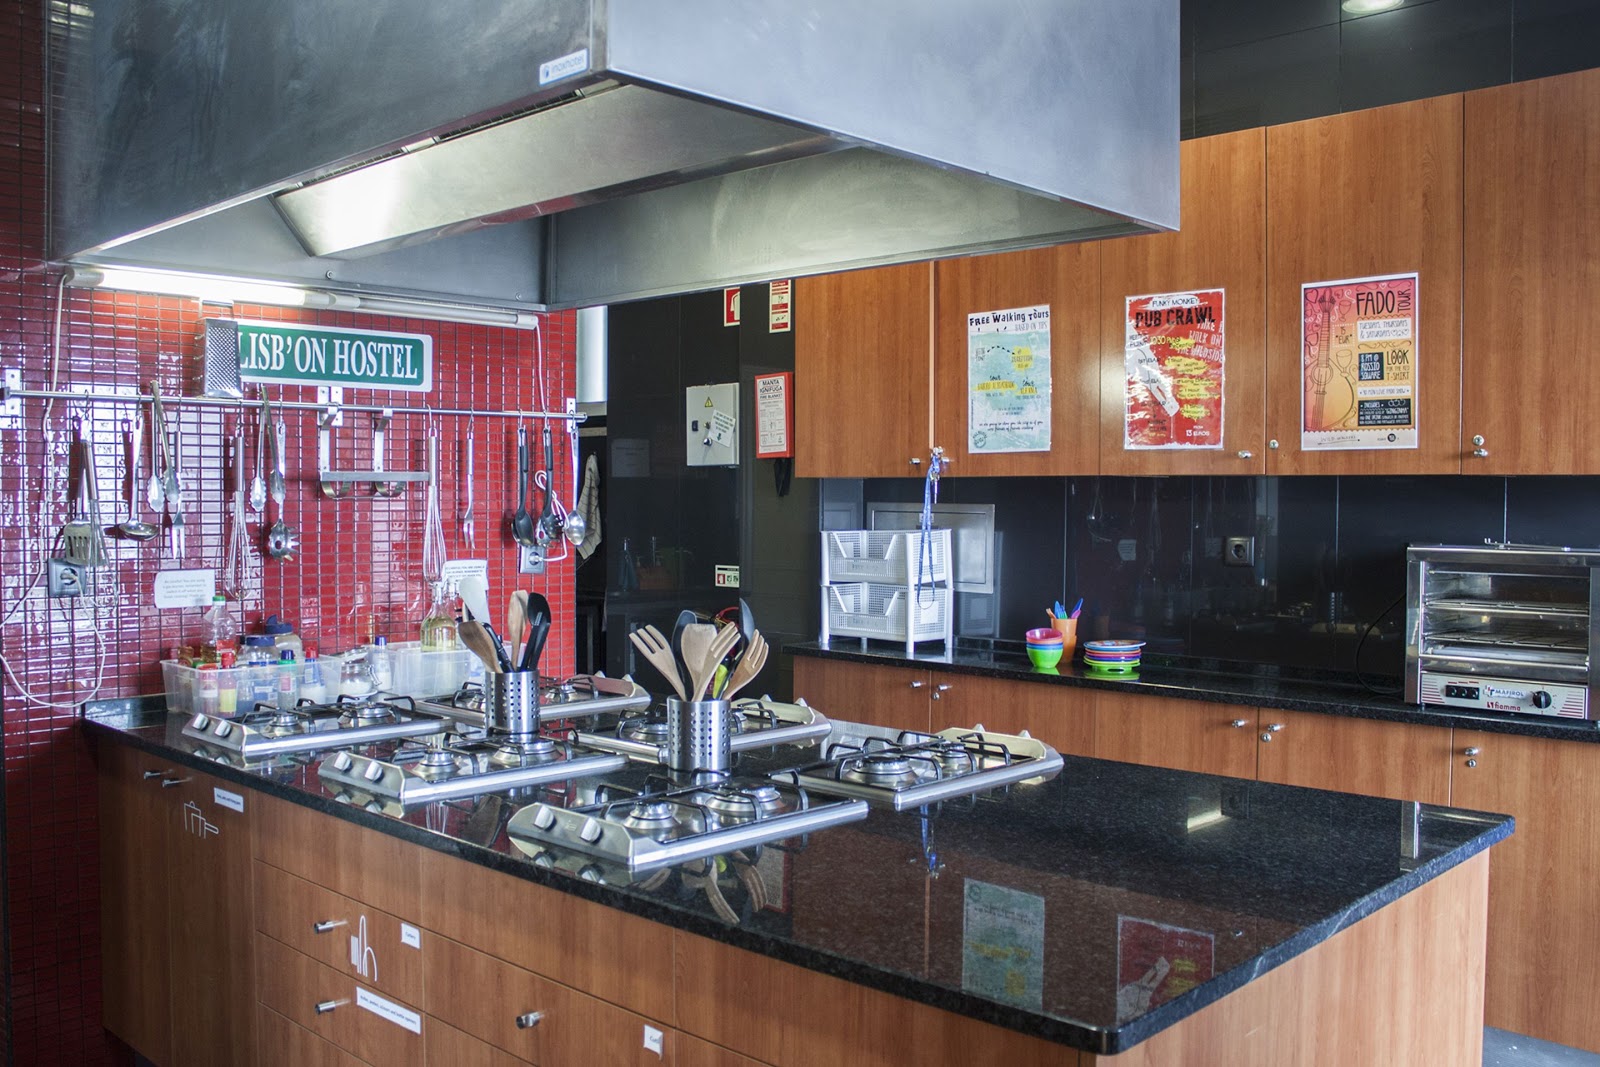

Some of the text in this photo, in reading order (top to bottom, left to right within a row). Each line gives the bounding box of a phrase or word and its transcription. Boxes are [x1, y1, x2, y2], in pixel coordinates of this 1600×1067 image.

[1172, 297, 1198, 305] MONKEY
[1356, 290, 1395, 316] FADO
[1397, 288, 1411, 313] TOUR
[969, 316, 990, 326] FREE
[991, 312, 1026, 323] Walking
[1135, 306, 1216, 328] PUB CRAWL
[1383, 319, 1408, 328] THURSDAYS
[332, 338, 418, 379] HOSTEL
[1386, 349, 1410, 365] LOOK
[1360, 362, 1380, 372] ROSSIO
[1361, 370, 1381, 380] SQUARE
[1386, 371, 1410, 380] T-SHIRT
[1494, 688, 1524, 697] MAFIROL
